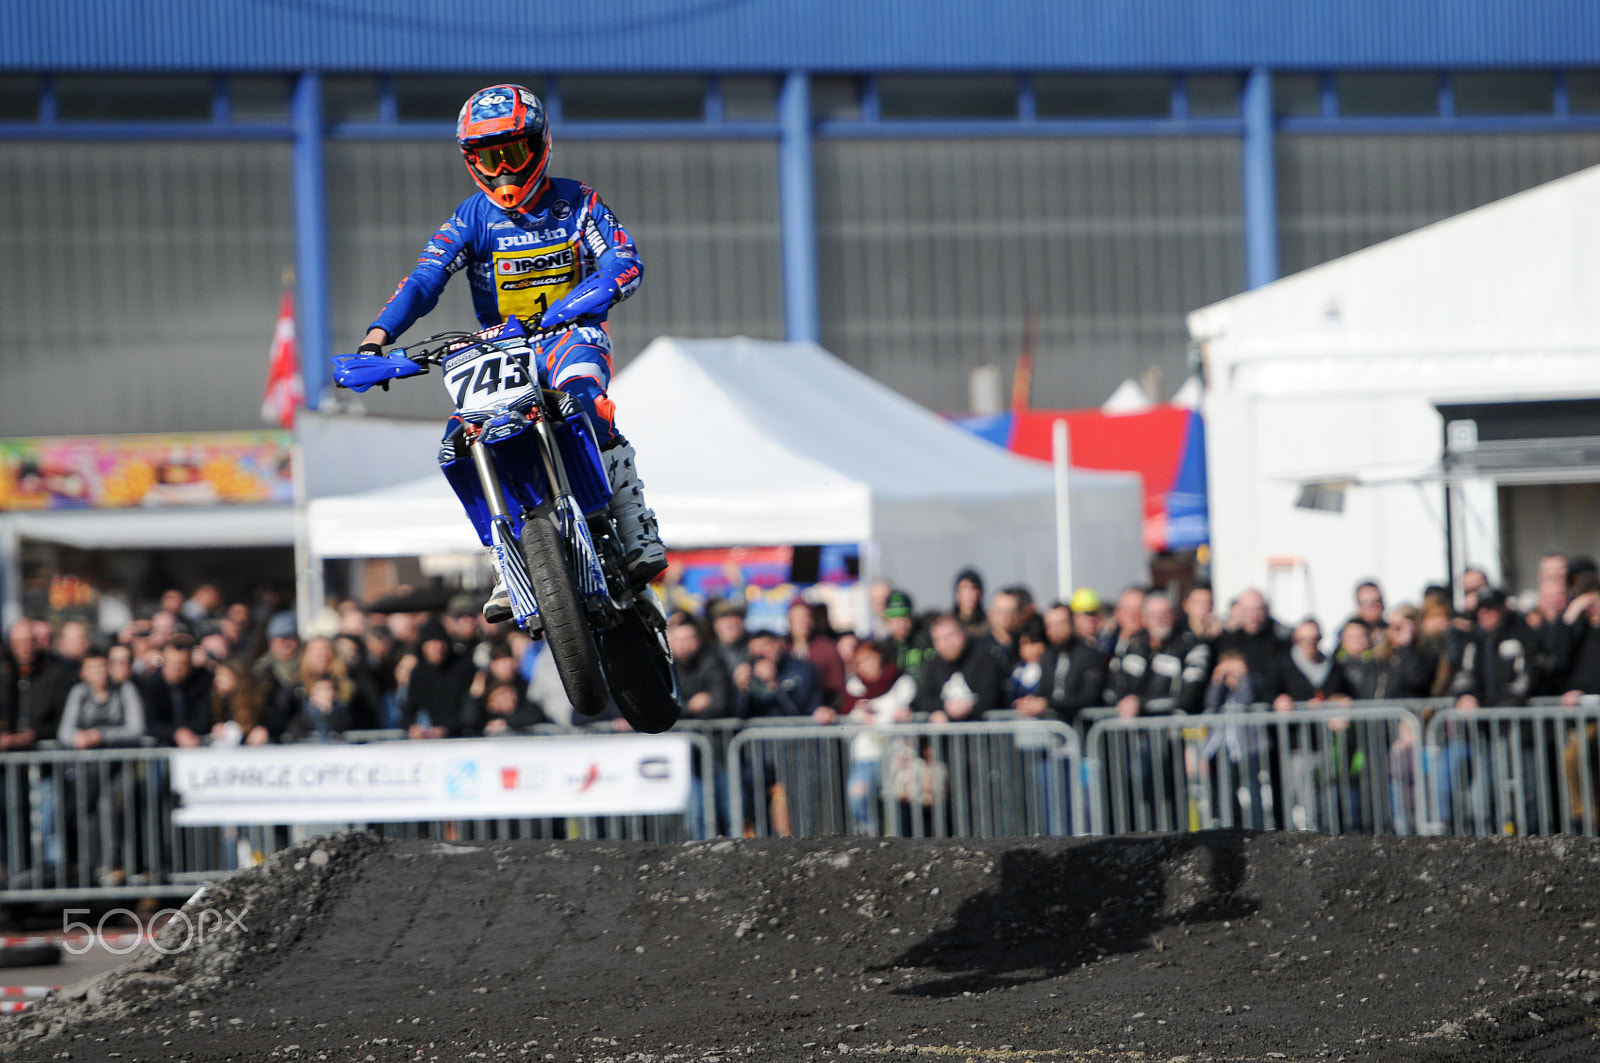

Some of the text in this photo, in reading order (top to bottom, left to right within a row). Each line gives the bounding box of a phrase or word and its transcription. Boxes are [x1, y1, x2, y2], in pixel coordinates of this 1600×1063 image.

[497, 227, 568, 250] pull-in
[515, 249, 572, 272] IPONE
[534, 292, 548, 313] 1
[451, 352, 531, 410] 743
